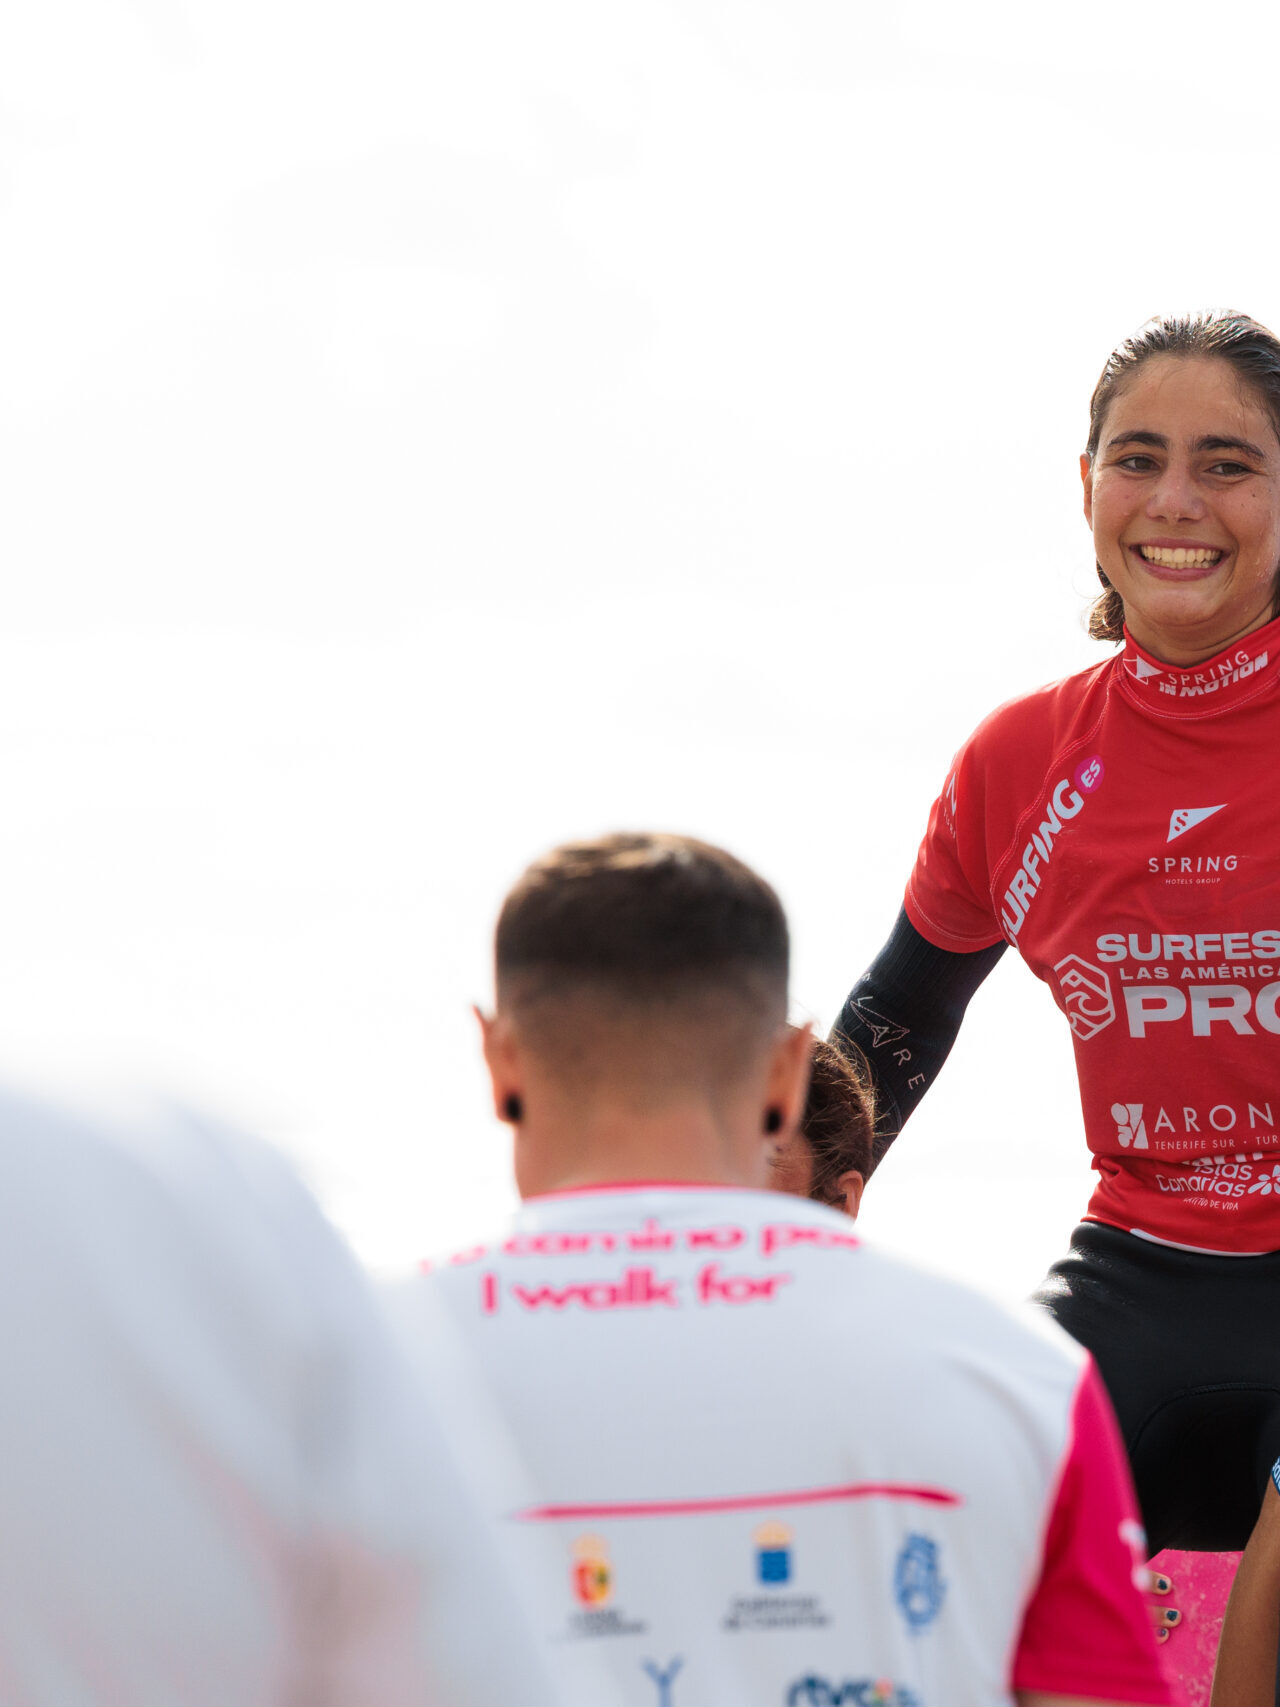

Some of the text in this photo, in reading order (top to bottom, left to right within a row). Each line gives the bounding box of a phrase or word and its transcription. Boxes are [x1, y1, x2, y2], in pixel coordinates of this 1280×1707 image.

[1159, 651, 1268, 697] IN MOTION
[1169, 650, 1249, 685] SPRING
[1080, 760, 1100, 788] ES
[1148, 855, 1238, 873] SPRING
[1119, 966, 1169, 981] LAS
[1155, 1139, 1207, 1151] TENERIFE
[1212, 1138, 1236, 1149] SUR
[1155, 1174, 1246, 1197] Canarias
[1222, 1201, 1239, 1211] VIDA
[512, 1265, 679, 1312] walk
[698, 1261, 793, 1306] for
